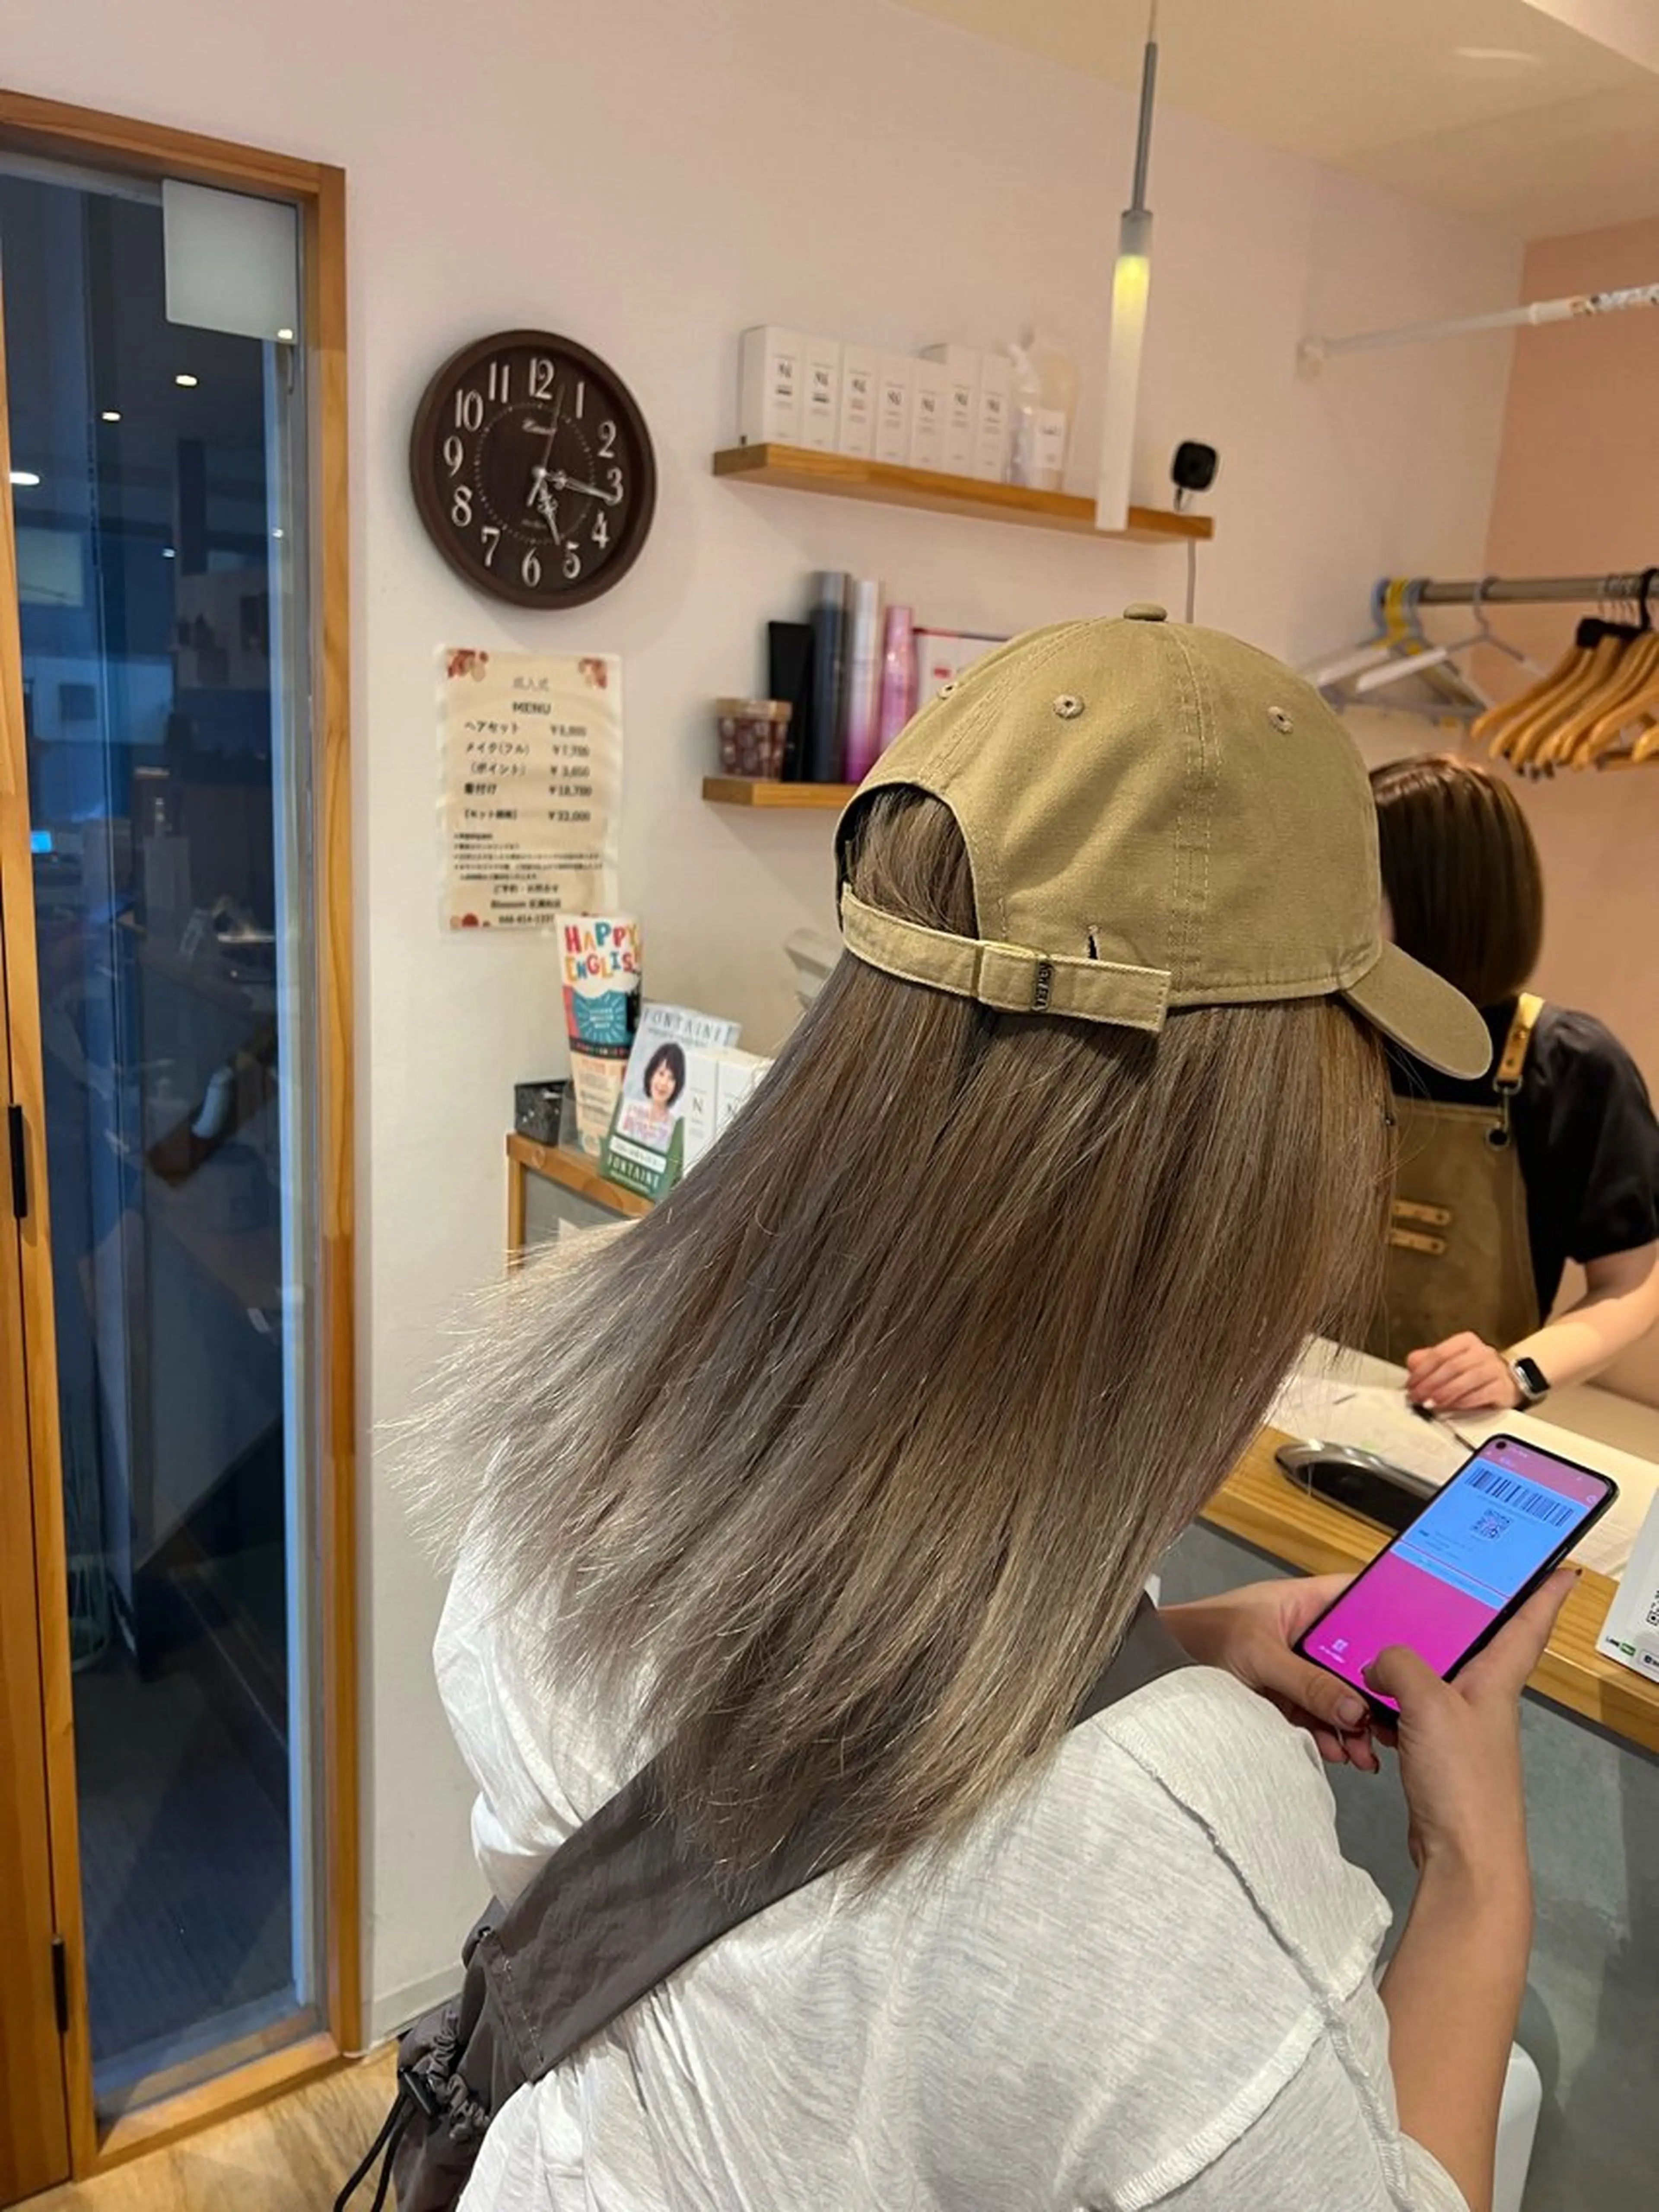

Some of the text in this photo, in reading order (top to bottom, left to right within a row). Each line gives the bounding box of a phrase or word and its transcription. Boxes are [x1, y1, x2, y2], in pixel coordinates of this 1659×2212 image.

[489, 362, 509, 403] 11
[529, 358, 553, 400] 12
[455, 389, 483, 431] 10
[576, 381, 585, 419] 1
[443, 435, 464, 477] 9
[598, 420, 617, 458] 2
[607, 467, 623, 505] 3
[451, 485, 472, 527] 8
[481, 526, 500, 566] 7
[591, 511, 610, 549] 4
[522, 547, 541, 587] 6
[563, 541, 581, 578] 5
[464, 720, 519, 734] ヘアセット
[512, 702, 551, 715] MENU
[565, 922, 637, 953] HAPPY
